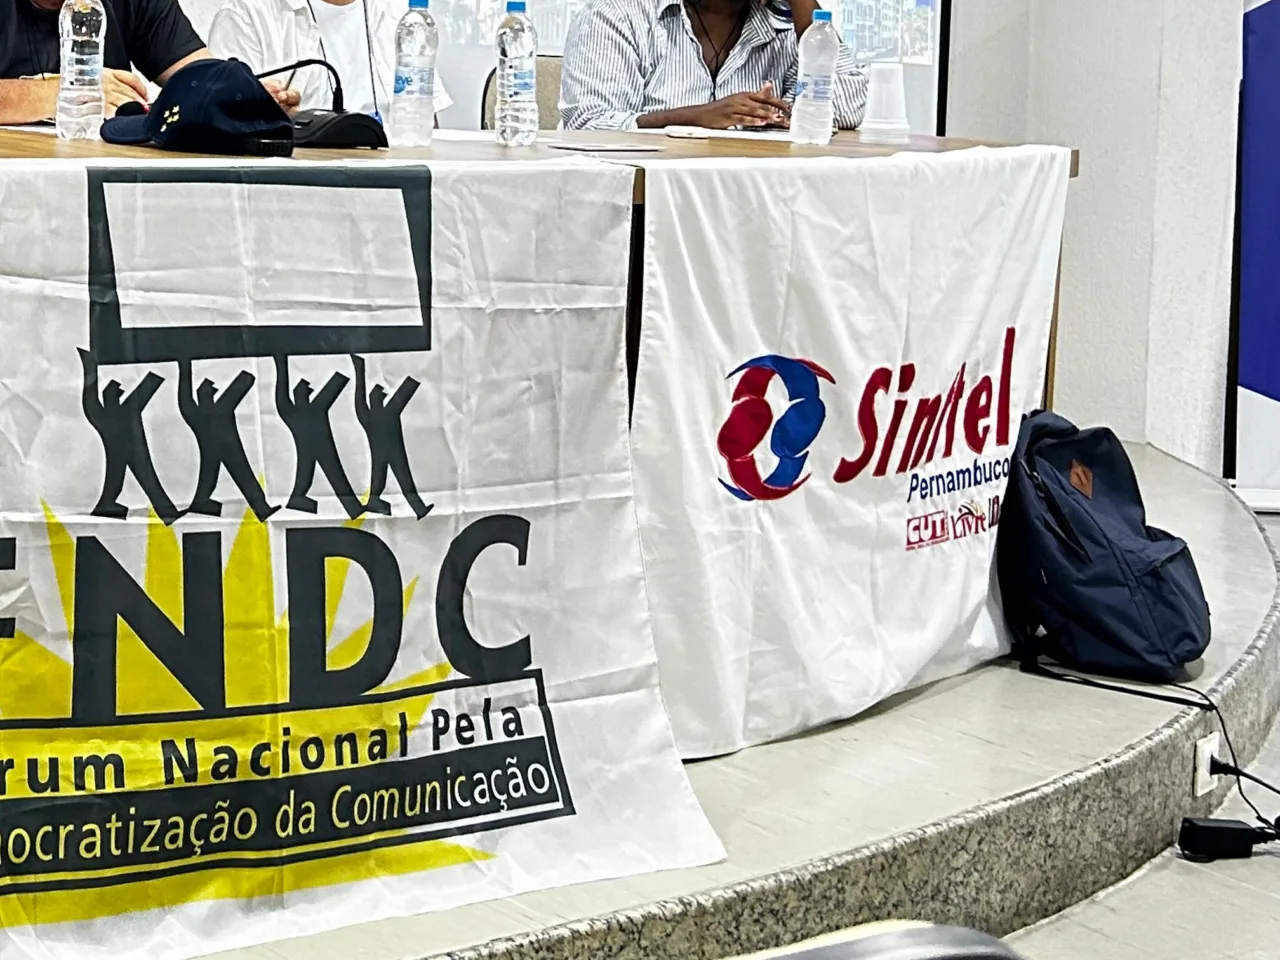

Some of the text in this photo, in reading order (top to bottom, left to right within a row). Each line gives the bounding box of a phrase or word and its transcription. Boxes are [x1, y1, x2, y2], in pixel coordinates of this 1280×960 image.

[906, 457, 1010, 503] Pernambuco
[163, 711, 410, 786] Nacional
[431, 697, 525, 748] Pela
[275, 790, 317, 838] da
[331, 756, 550, 830] Comunicação
